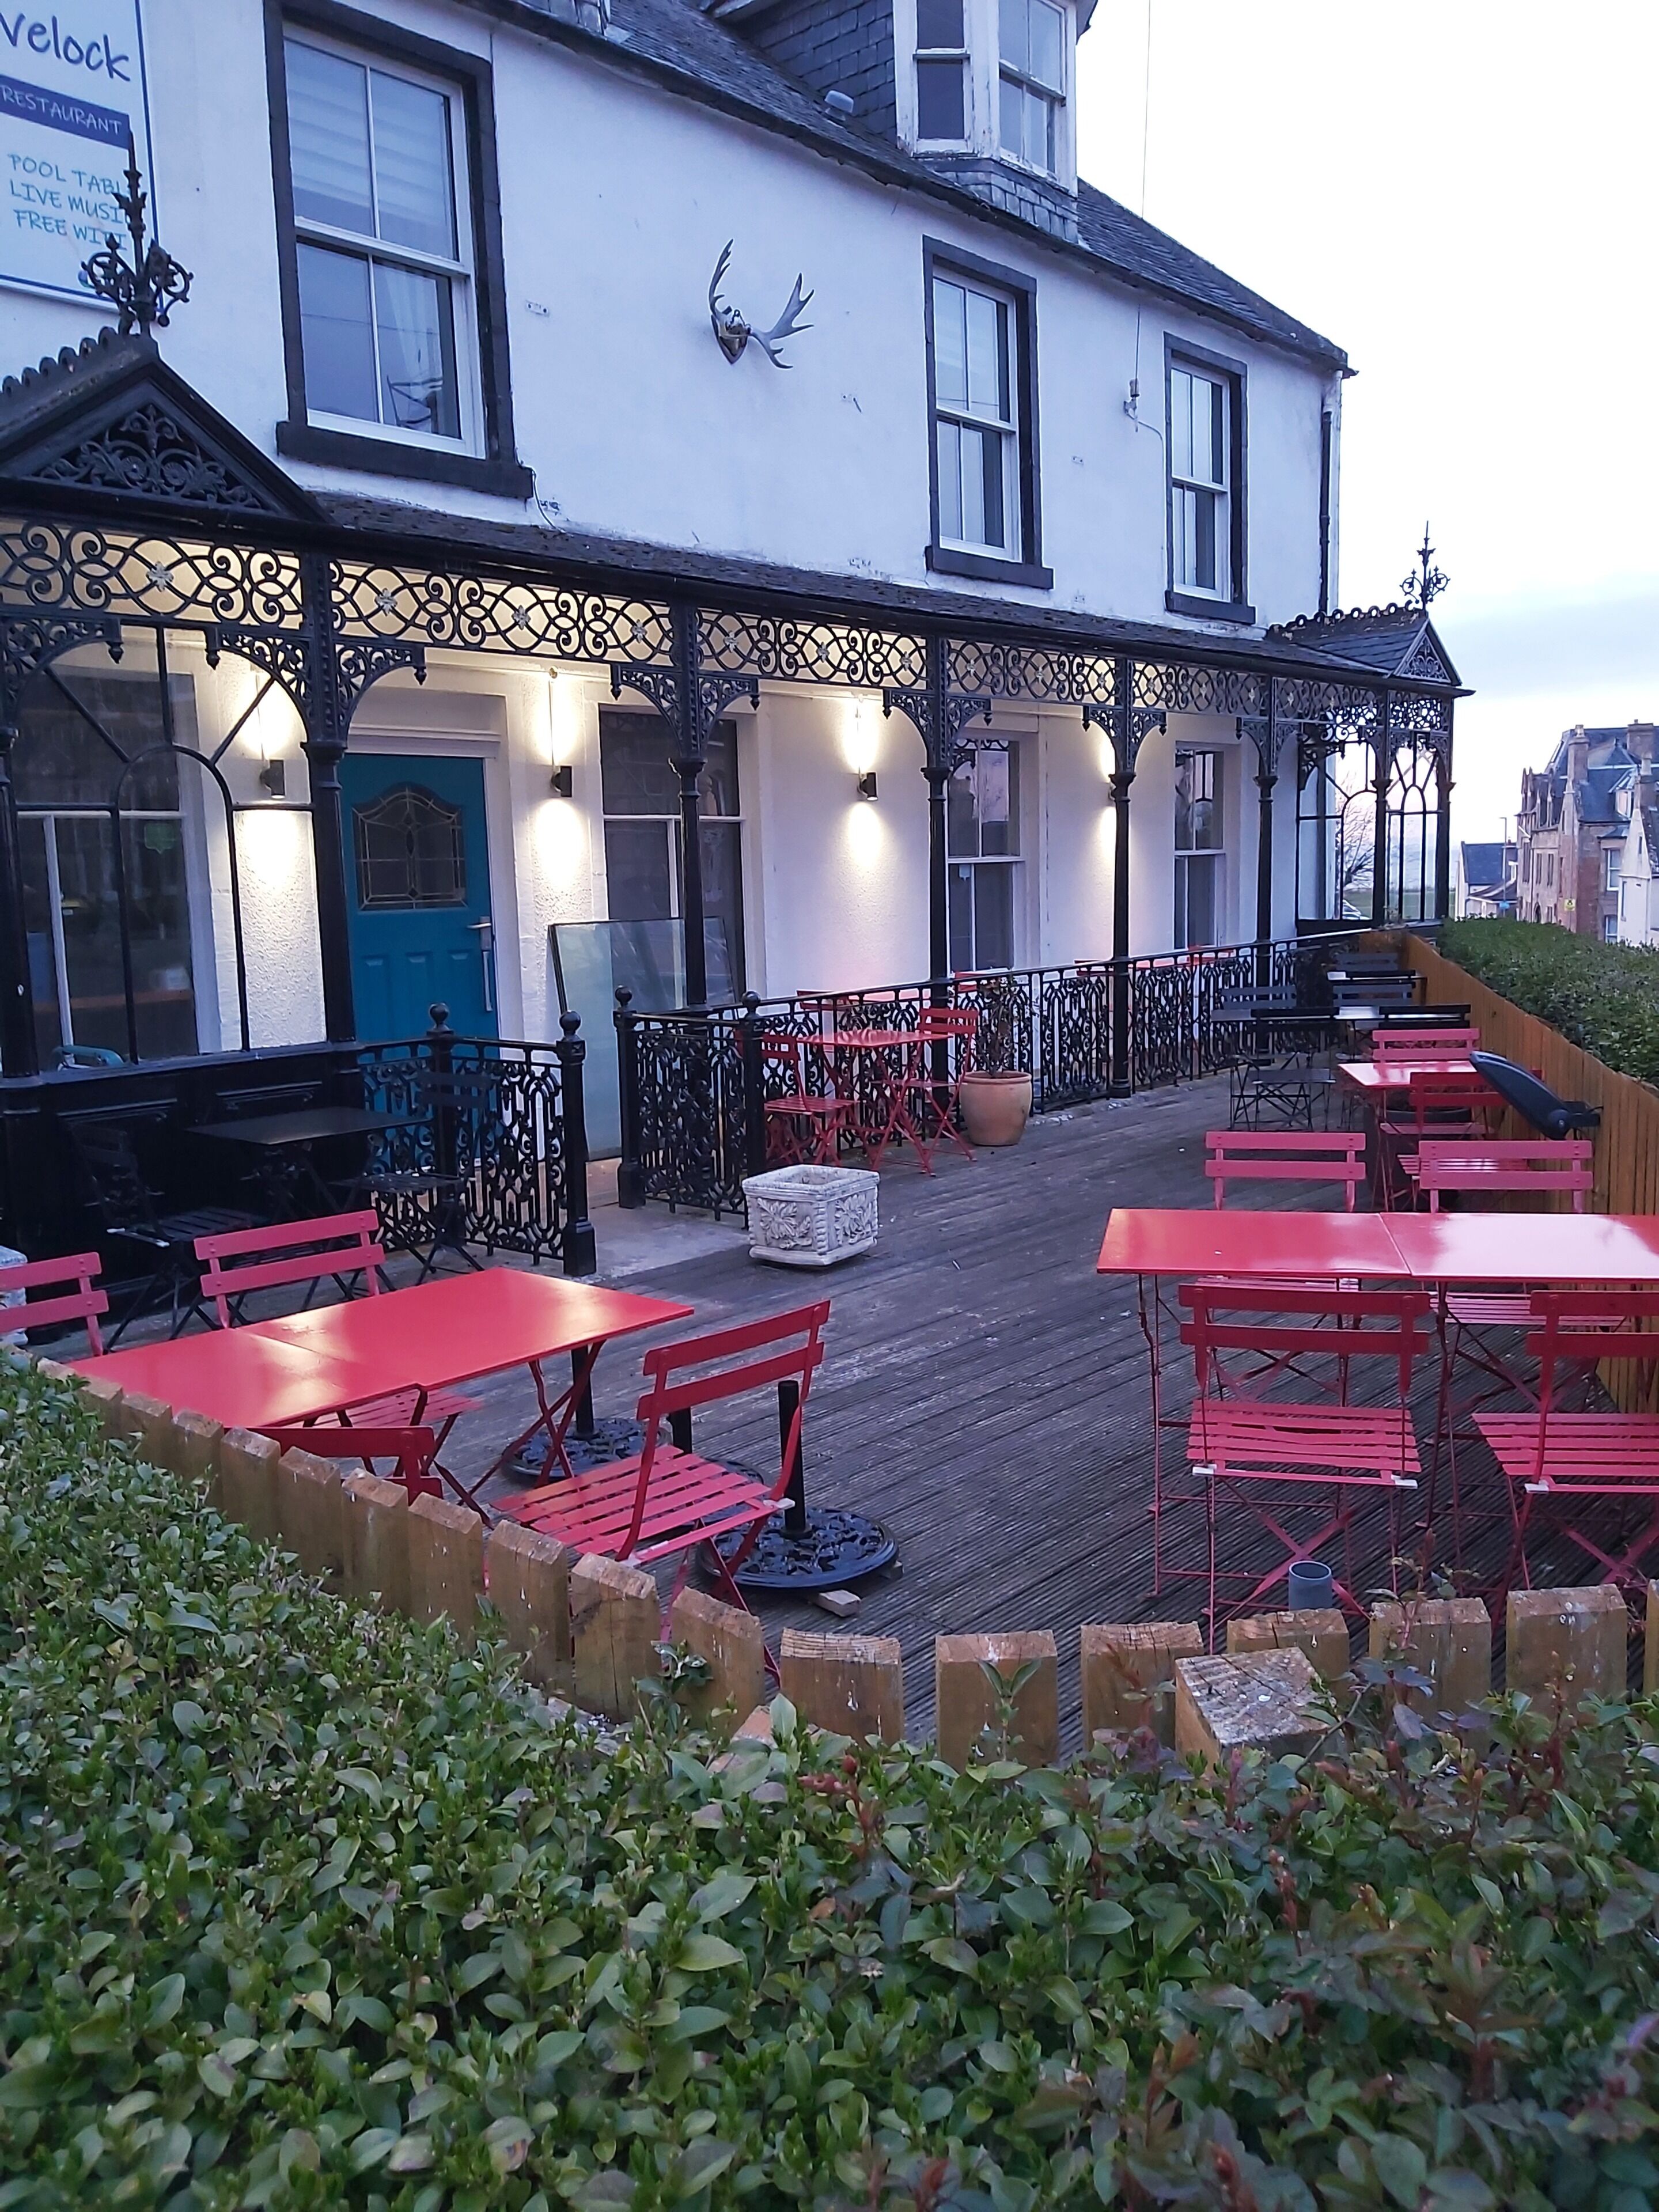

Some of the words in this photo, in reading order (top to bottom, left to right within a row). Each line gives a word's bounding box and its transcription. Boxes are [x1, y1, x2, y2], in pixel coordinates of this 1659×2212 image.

[2, 85, 122, 135] RESTAURANT
[7, 154, 66, 182] POOL
[71, 170, 131, 195] TABL
[10, 179, 62, 209] LIVE
[68, 195, 129, 224] MUSI
[13, 209, 67, 236] FREE
